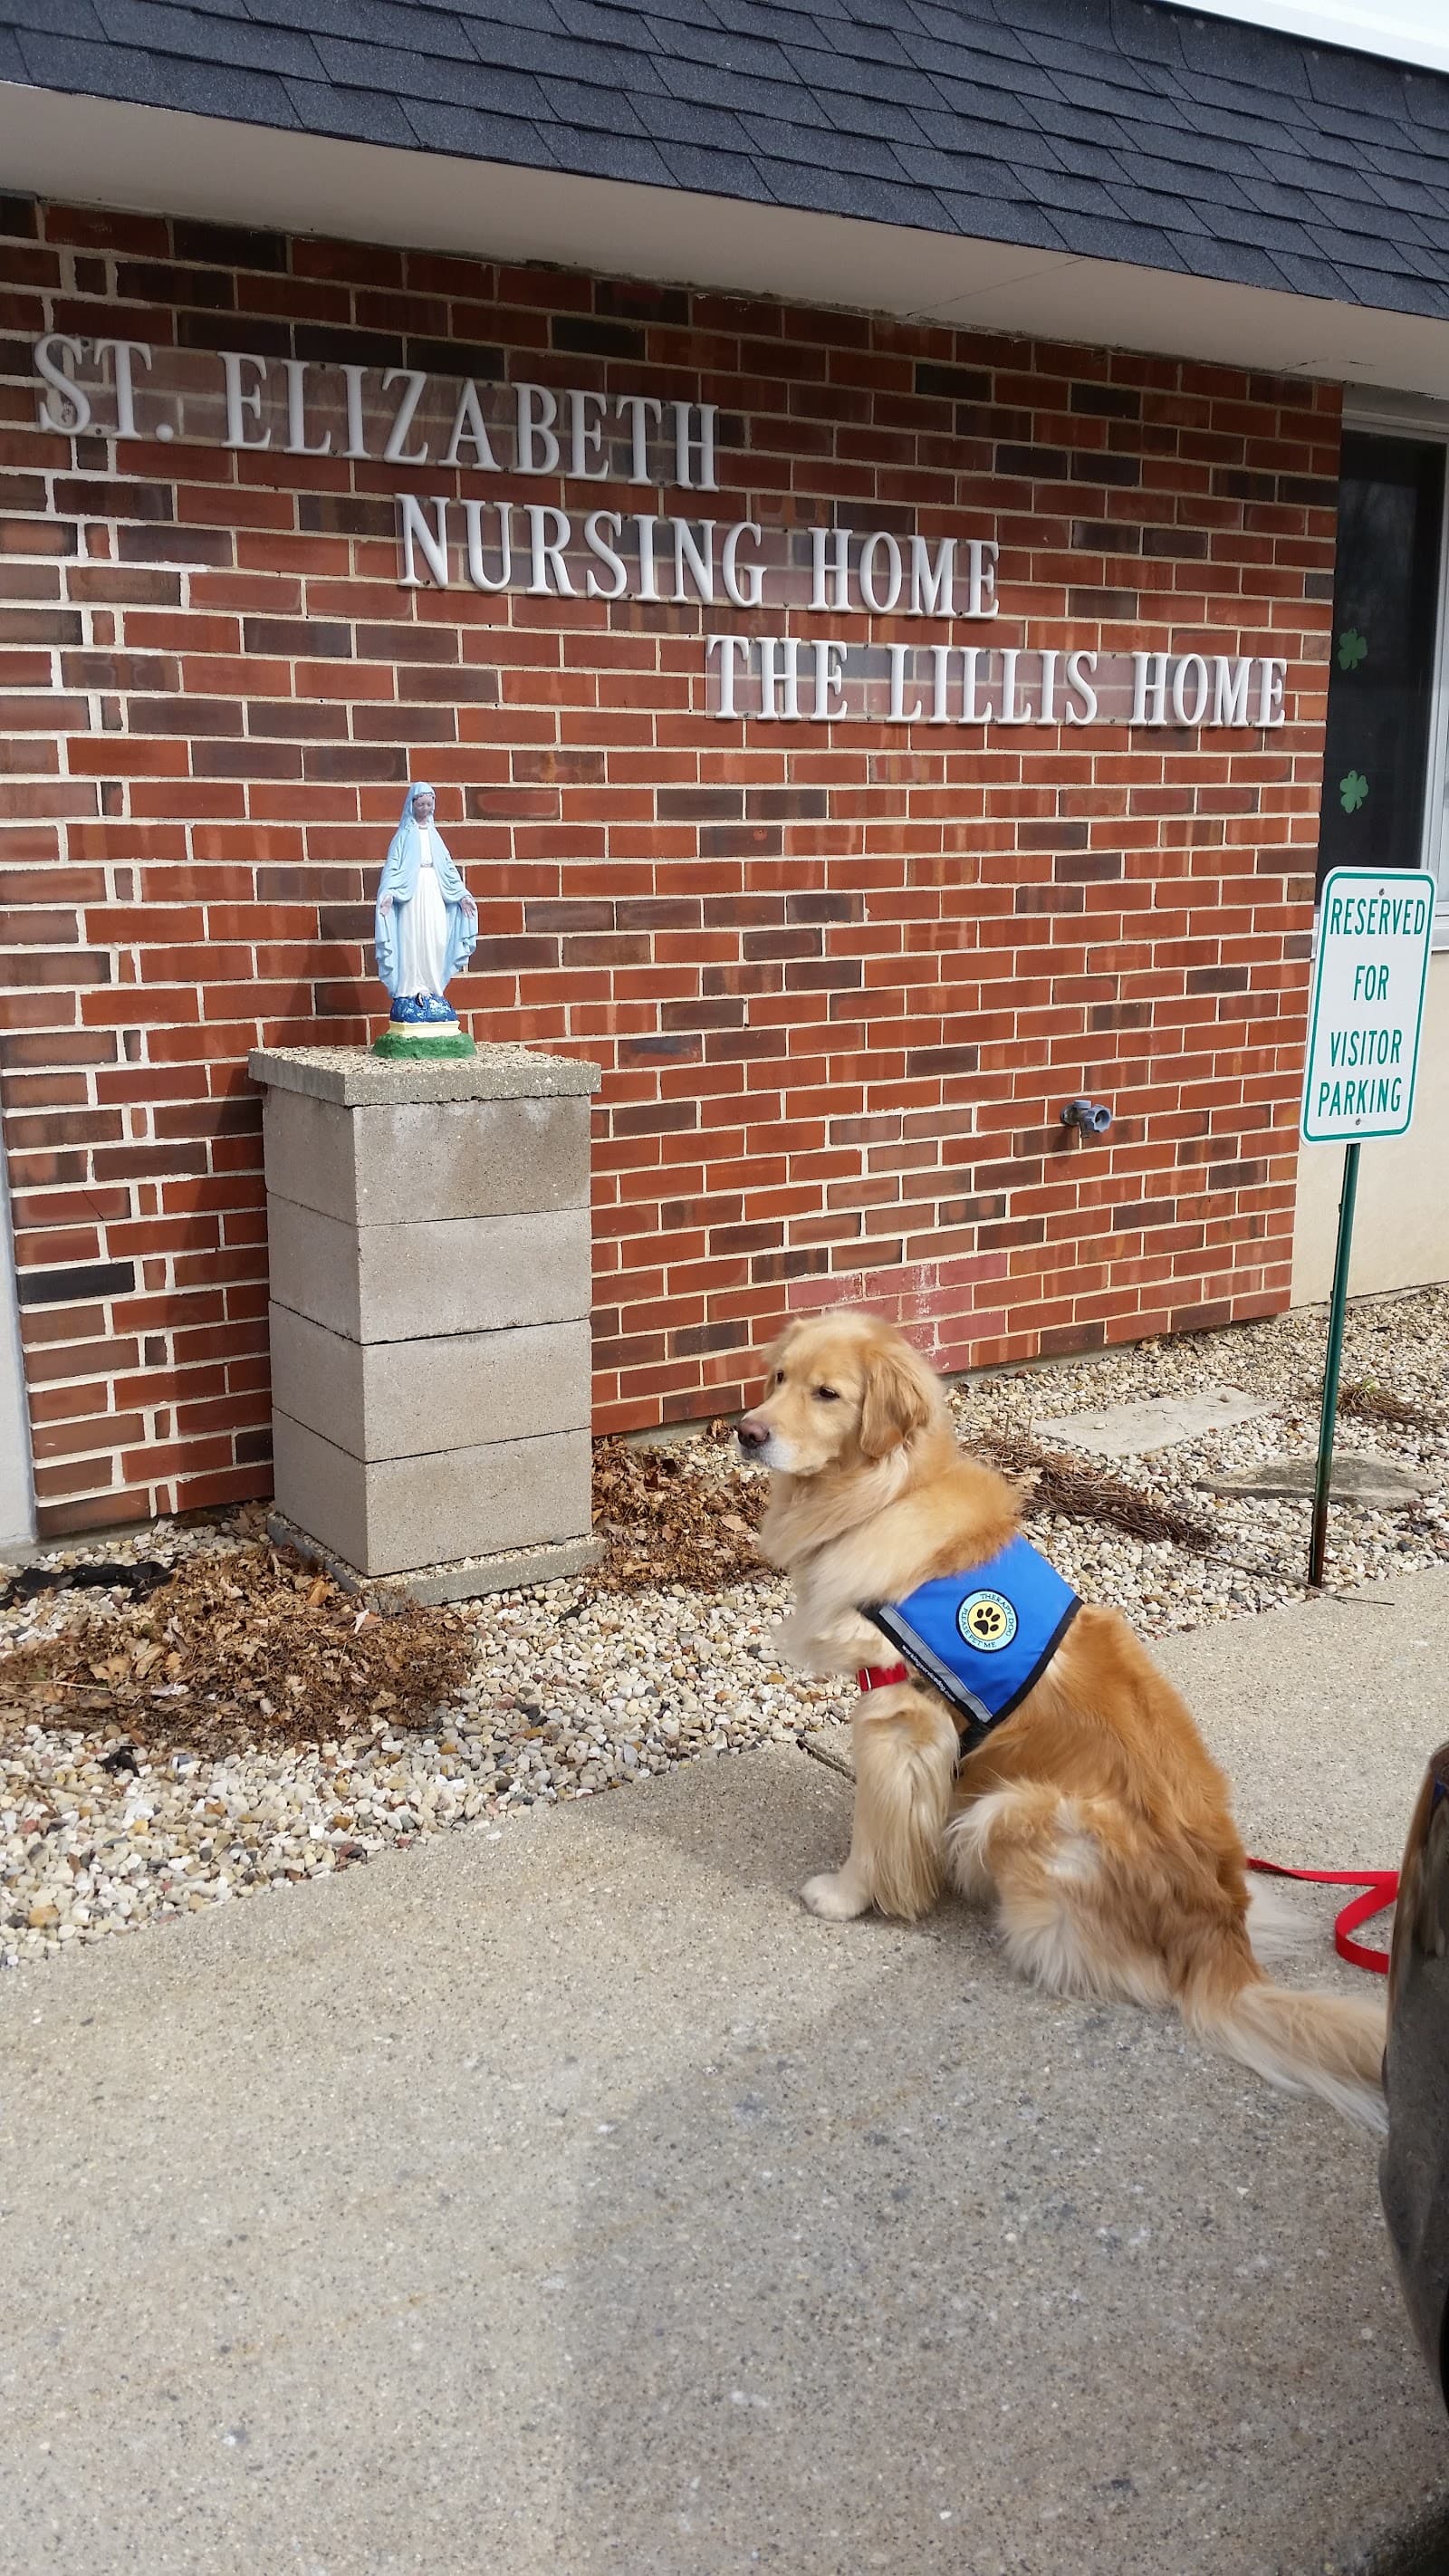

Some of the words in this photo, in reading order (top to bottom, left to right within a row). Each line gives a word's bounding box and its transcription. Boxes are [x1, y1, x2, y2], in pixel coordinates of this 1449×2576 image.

[34, 333, 174, 443] ST.
[217, 350, 719, 492] ELIZABETH
[396, 493, 766, 609] NURSING
[808, 527, 999, 618] HOME
[706, 635, 848, 721] THE
[887, 643, 1098, 726] LILLIS
[1128, 651, 1287, 727] HOME
[1329, 898, 1425, 936] RESERVED
[1353, 965, 1389, 1001] FOR
[1330, 1029, 1402, 1067] VISITOR
[1318, 1077, 1402, 1117] PARKING
[980, 1593, 1012, 1615] THERAPY
[961, 1608, 970, 1635] PLEASE
[969, 1634, 983, 1646] PET
